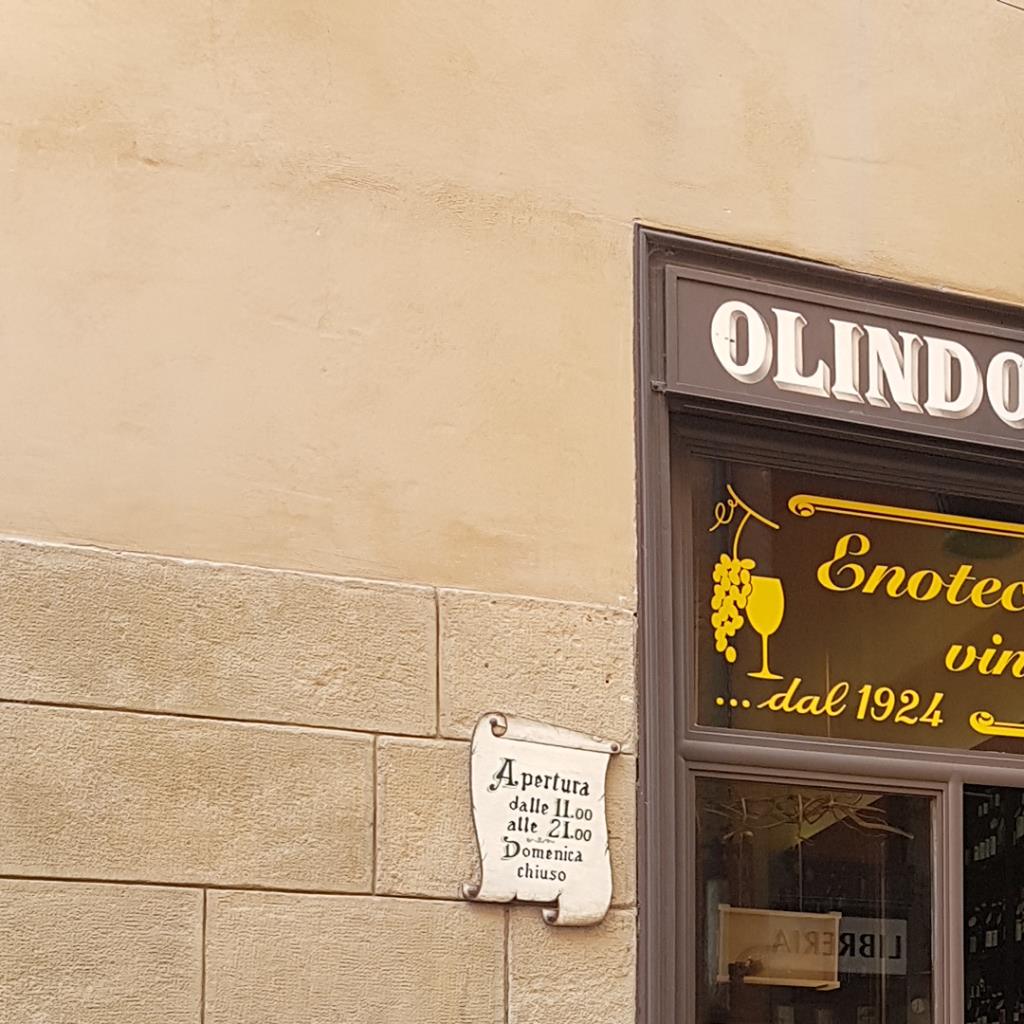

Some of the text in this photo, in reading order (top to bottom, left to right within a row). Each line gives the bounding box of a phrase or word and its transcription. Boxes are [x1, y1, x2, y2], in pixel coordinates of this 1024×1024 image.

[857, 684, 944, 728] 1924
[488, 757, 590, 797] Apertura
[508, 796, 593, 821] dalle 11.00
[507, 816, 593, 841] alle 21.00
[502, 836, 583, 862] Domenica
[517, 862, 567, 882] chiuso
